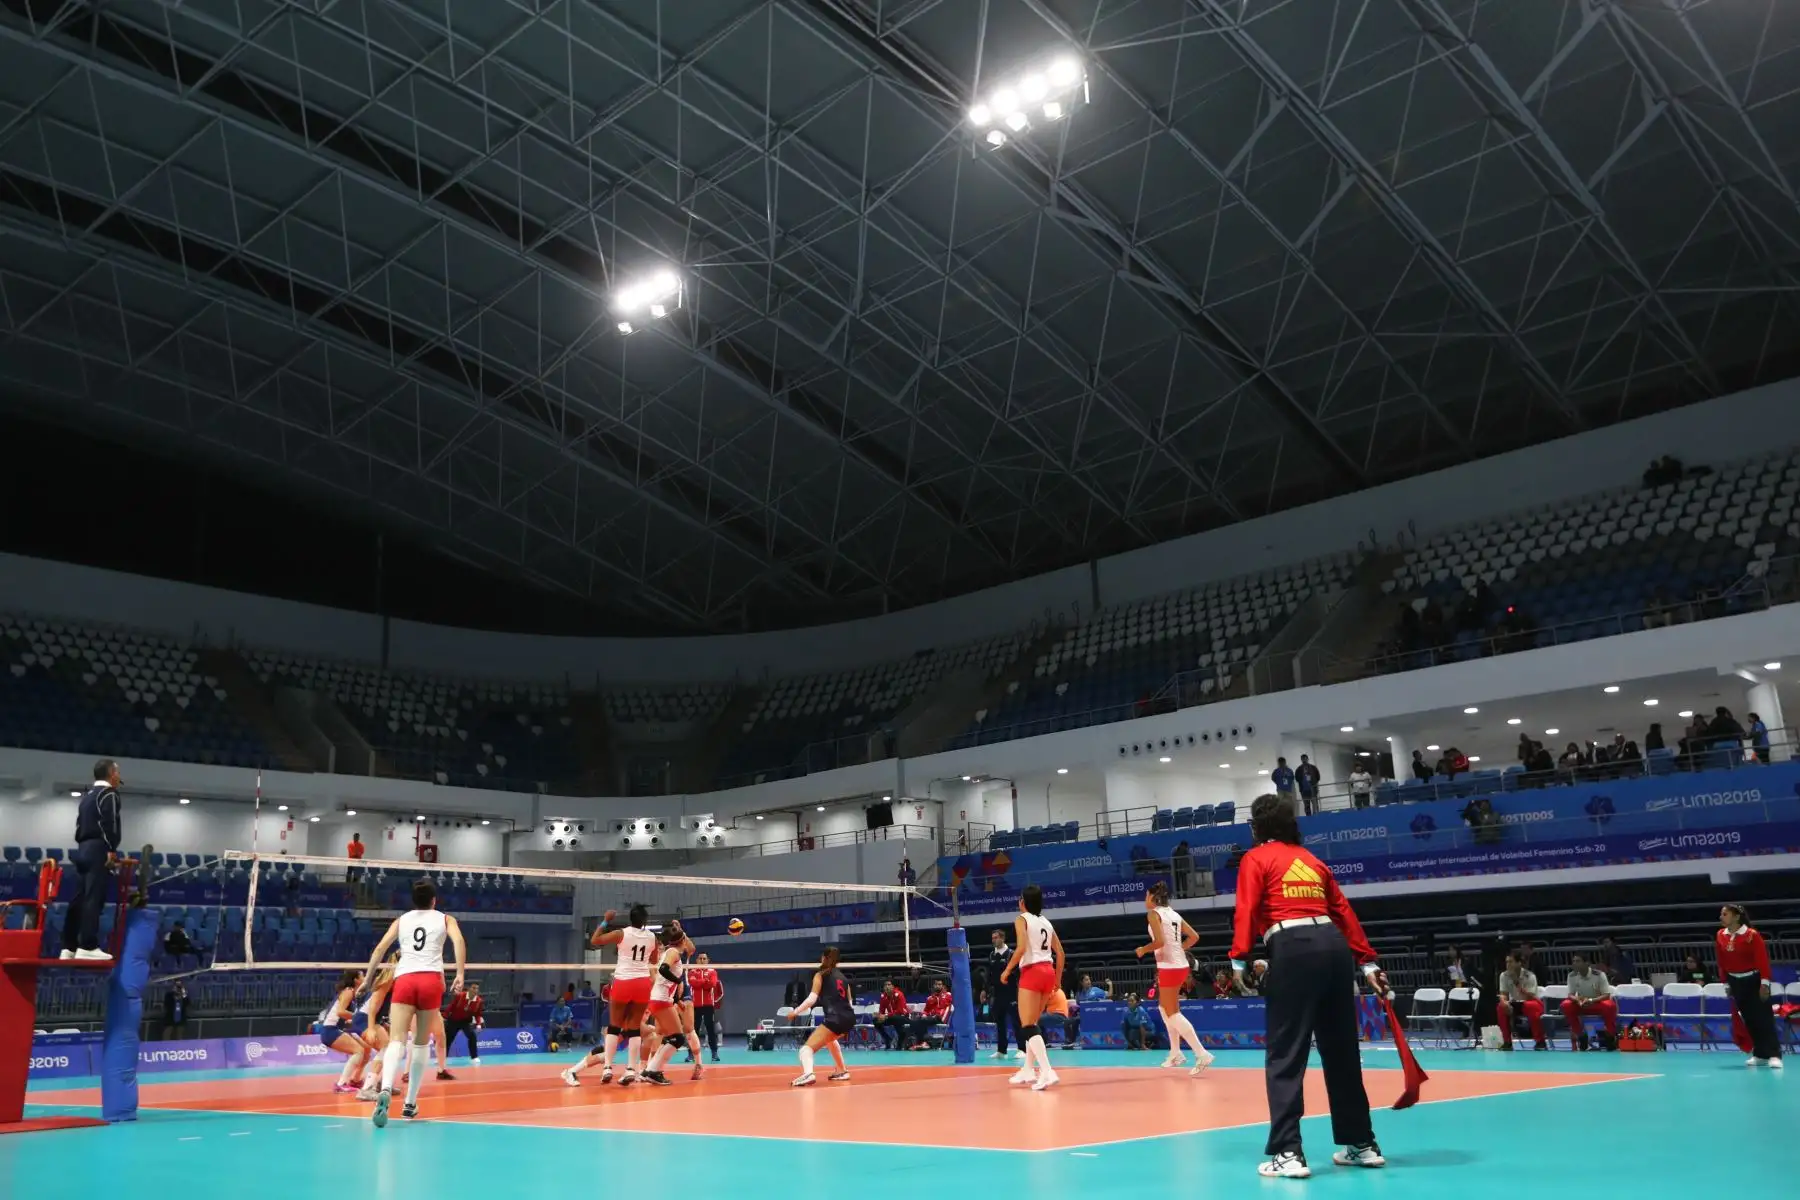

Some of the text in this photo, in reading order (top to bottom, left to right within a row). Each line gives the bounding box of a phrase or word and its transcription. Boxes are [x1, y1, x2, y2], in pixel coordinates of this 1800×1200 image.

[1388, 844, 1606, 869] Cuadrangular Internacional de Voleibol Femenino Sub-20
[413, 926, 427, 952] 9
[1040, 928, 1048, 950] 2
[1171, 921, 1178, 942] 7
[631, 944, 646, 961] 11
[836, 979, 846, 1000] 5
